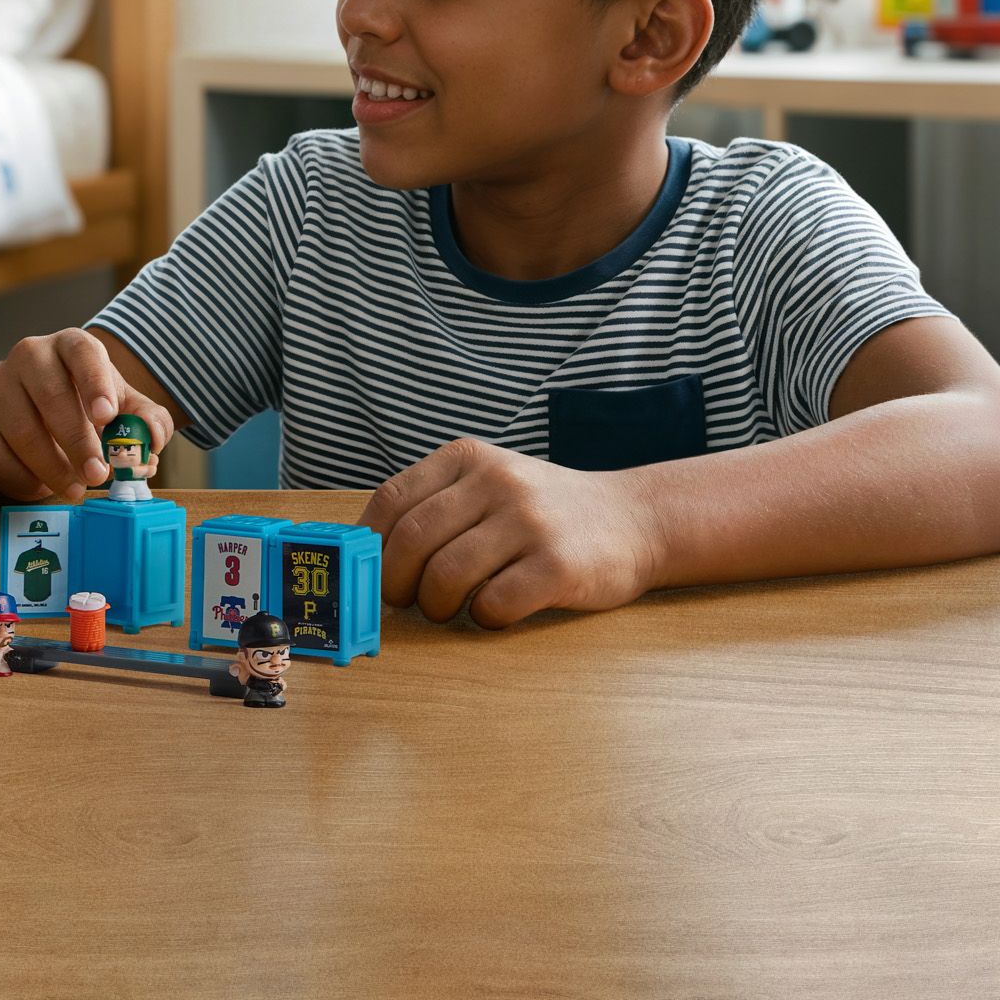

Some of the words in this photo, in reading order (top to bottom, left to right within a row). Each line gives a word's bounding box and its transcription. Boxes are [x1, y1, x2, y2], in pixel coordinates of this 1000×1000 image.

[217, 542, 248, 556] HARPER
[291, 551, 330, 568] SKENES
[224, 555, 240, 587] 3
[291, 566, 330, 597] 30
[304, 601, 317, 620] P
[294, 626, 327, 640] PIRATES
